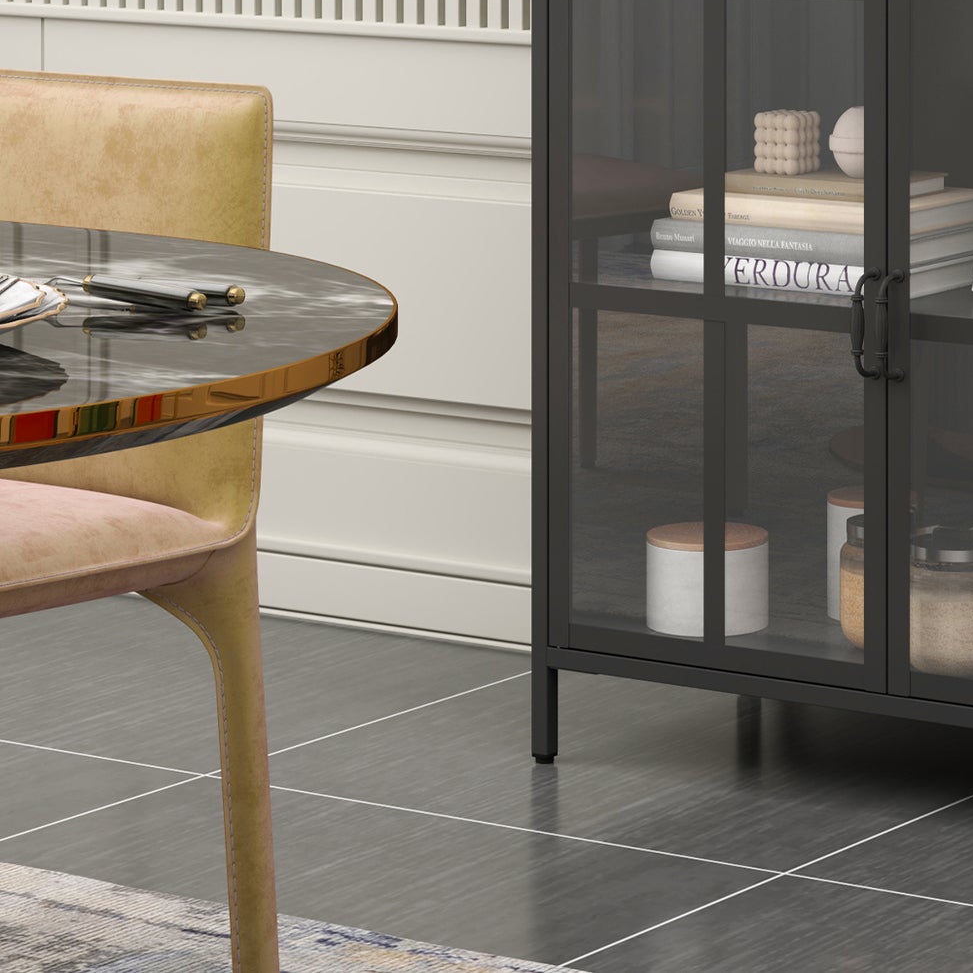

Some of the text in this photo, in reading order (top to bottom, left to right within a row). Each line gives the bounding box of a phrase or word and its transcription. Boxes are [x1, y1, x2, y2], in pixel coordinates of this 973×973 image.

[674, 233, 695, 242] Munari
[728, 237, 813, 252] VIAGGIO NELLA FANTASIA
